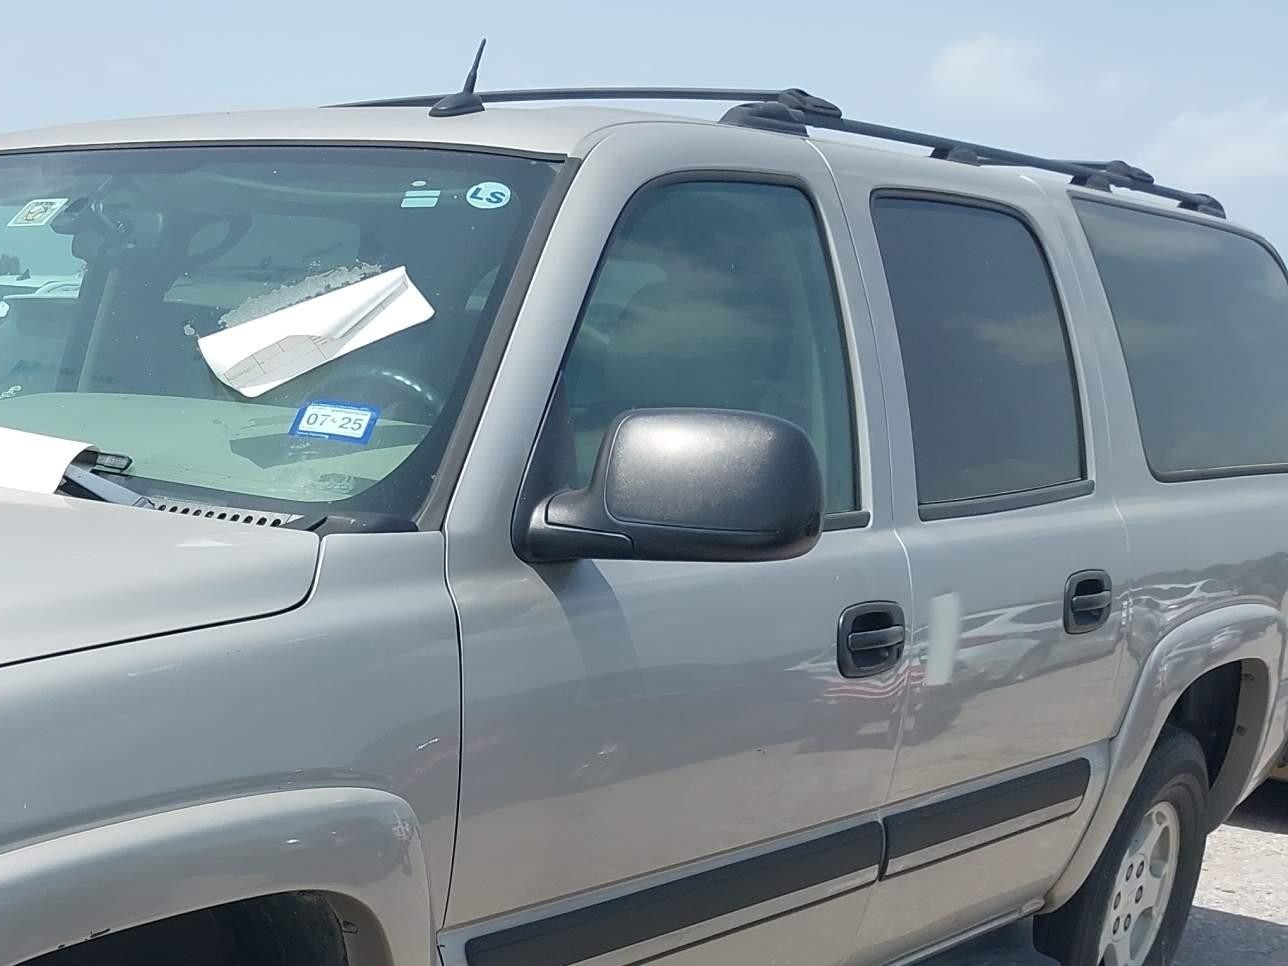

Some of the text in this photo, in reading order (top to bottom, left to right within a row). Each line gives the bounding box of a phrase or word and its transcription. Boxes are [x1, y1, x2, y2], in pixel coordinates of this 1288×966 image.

[469, 186, 506, 204] LS
[306, 413, 364, 431] 07 25
